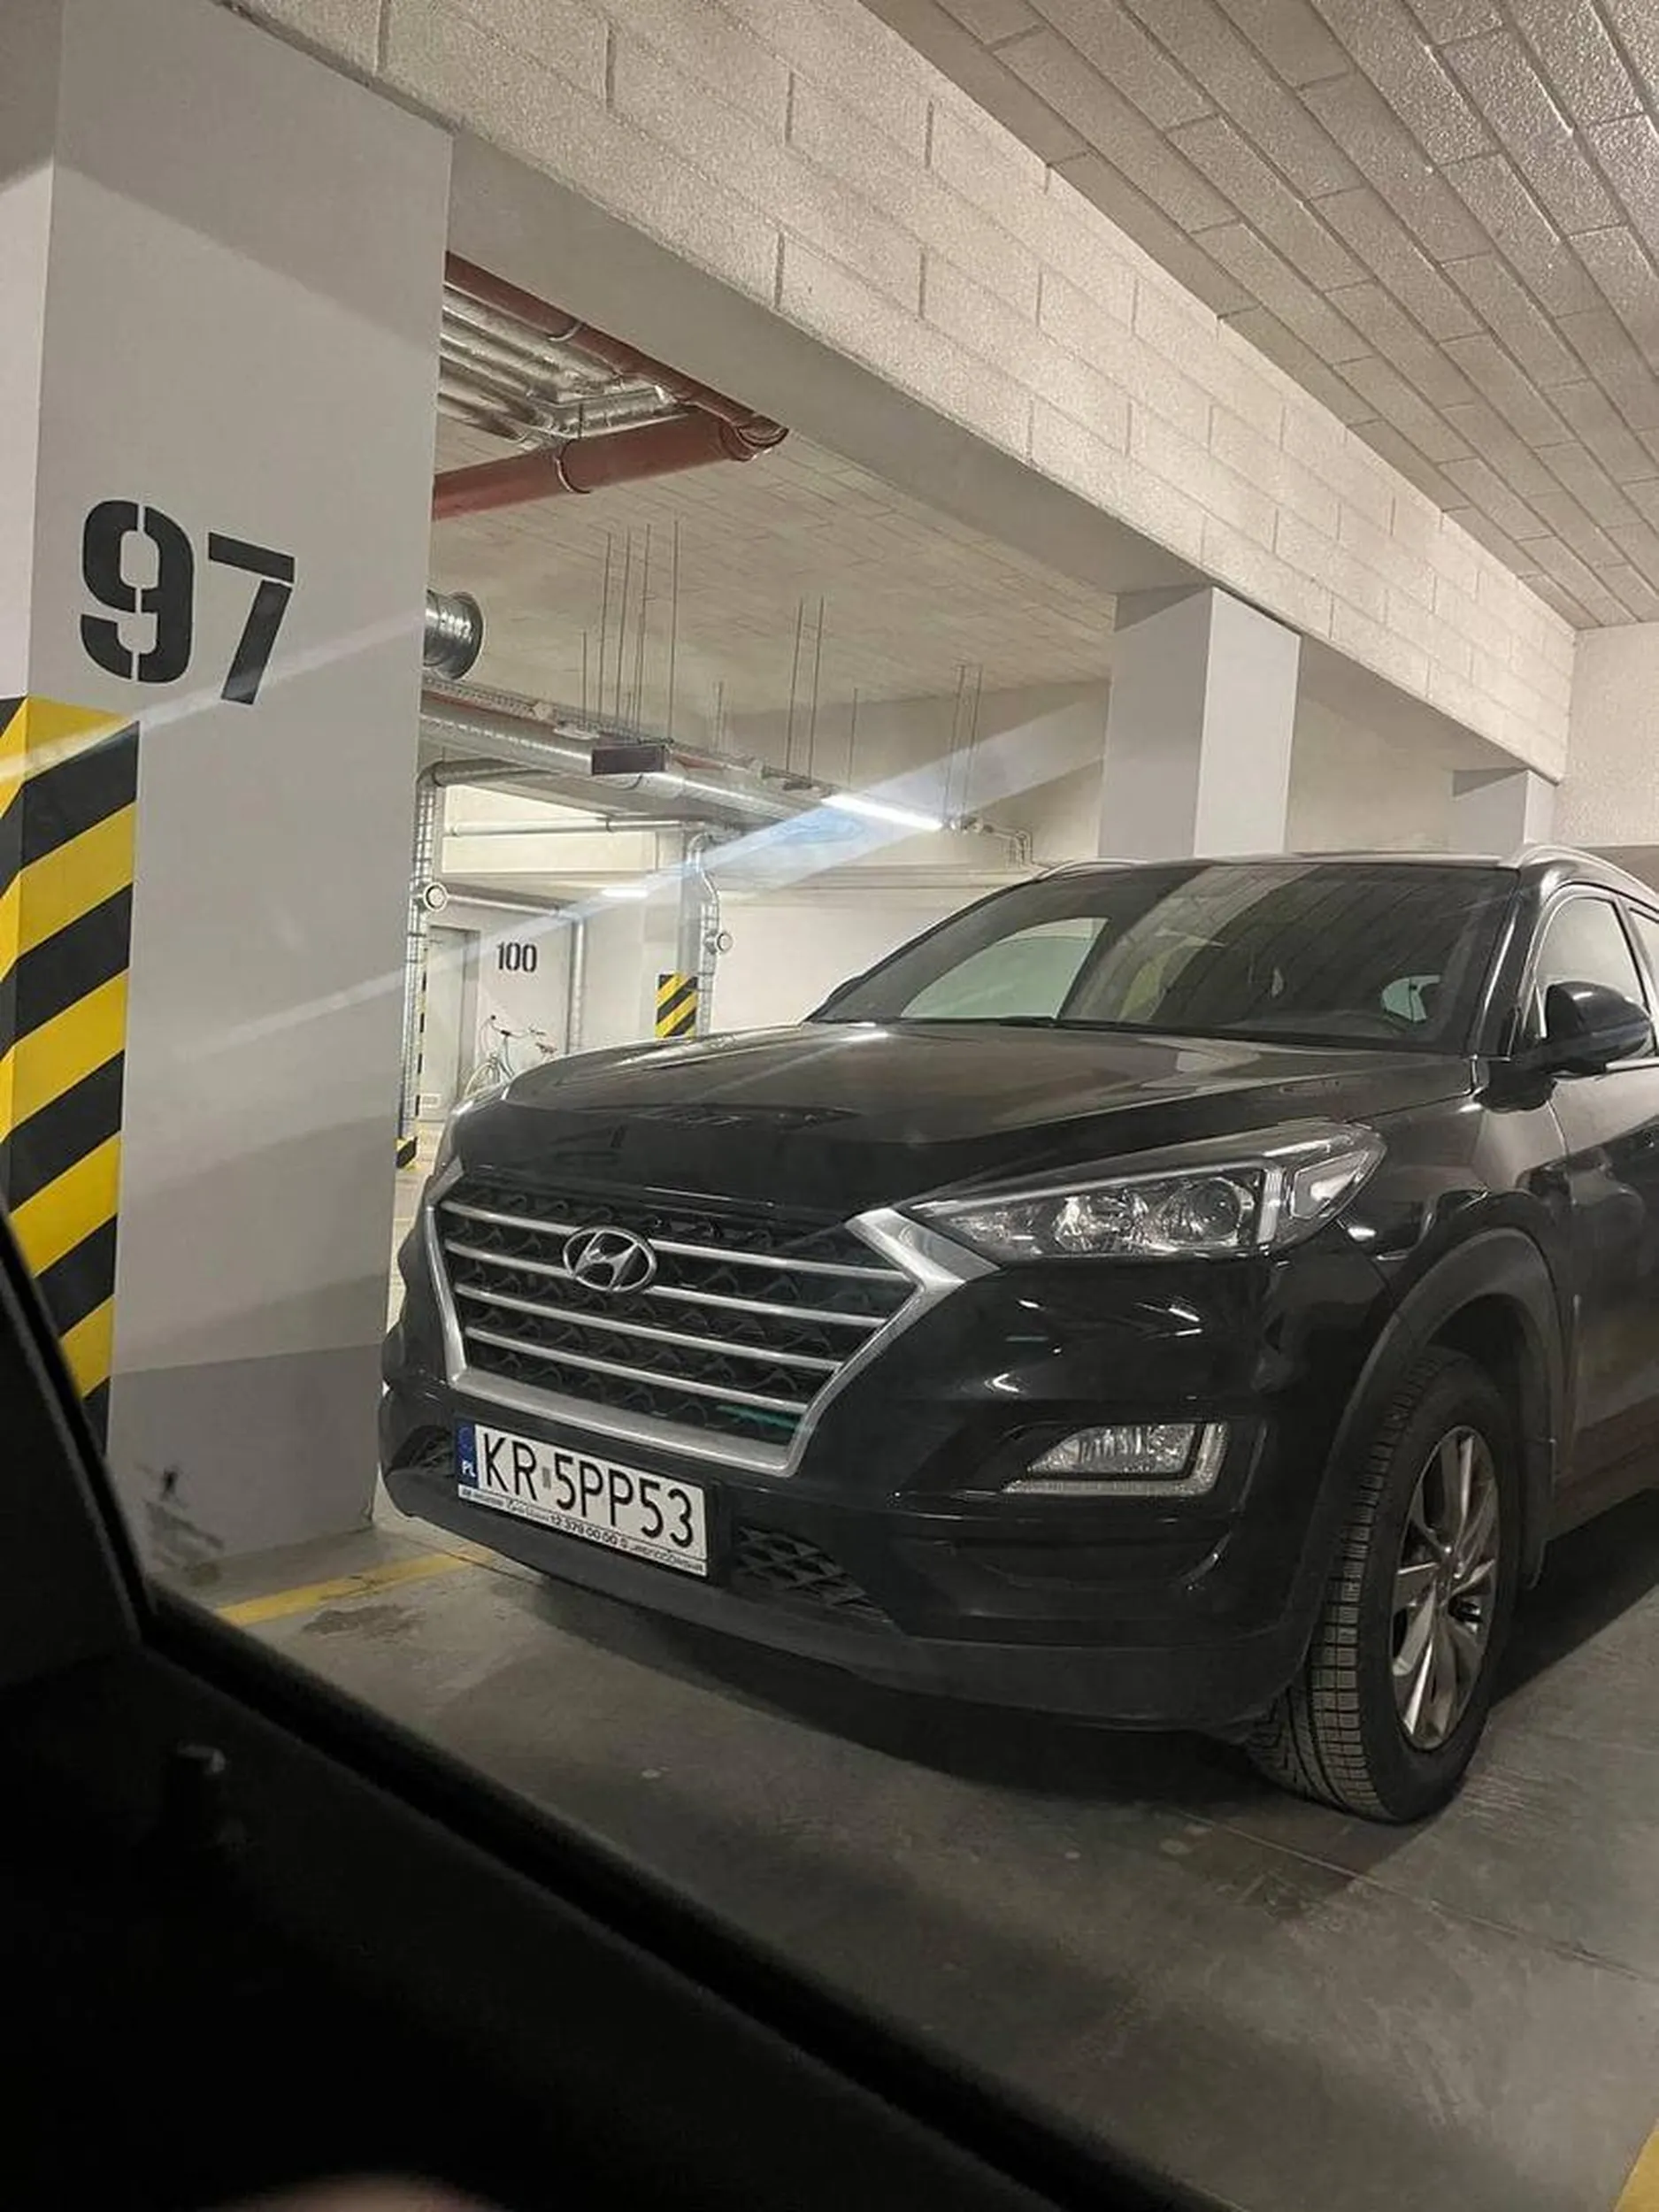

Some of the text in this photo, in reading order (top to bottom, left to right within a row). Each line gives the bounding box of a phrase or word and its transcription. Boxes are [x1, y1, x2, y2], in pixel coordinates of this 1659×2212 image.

[81, 500, 295, 704] 97
[497, 941, 537, 972] 100
[461, 1460, 477, 1478] PL
[484, 1432, 537, 1502] KR
[554, 1453, 693, 1548] 5PP53
